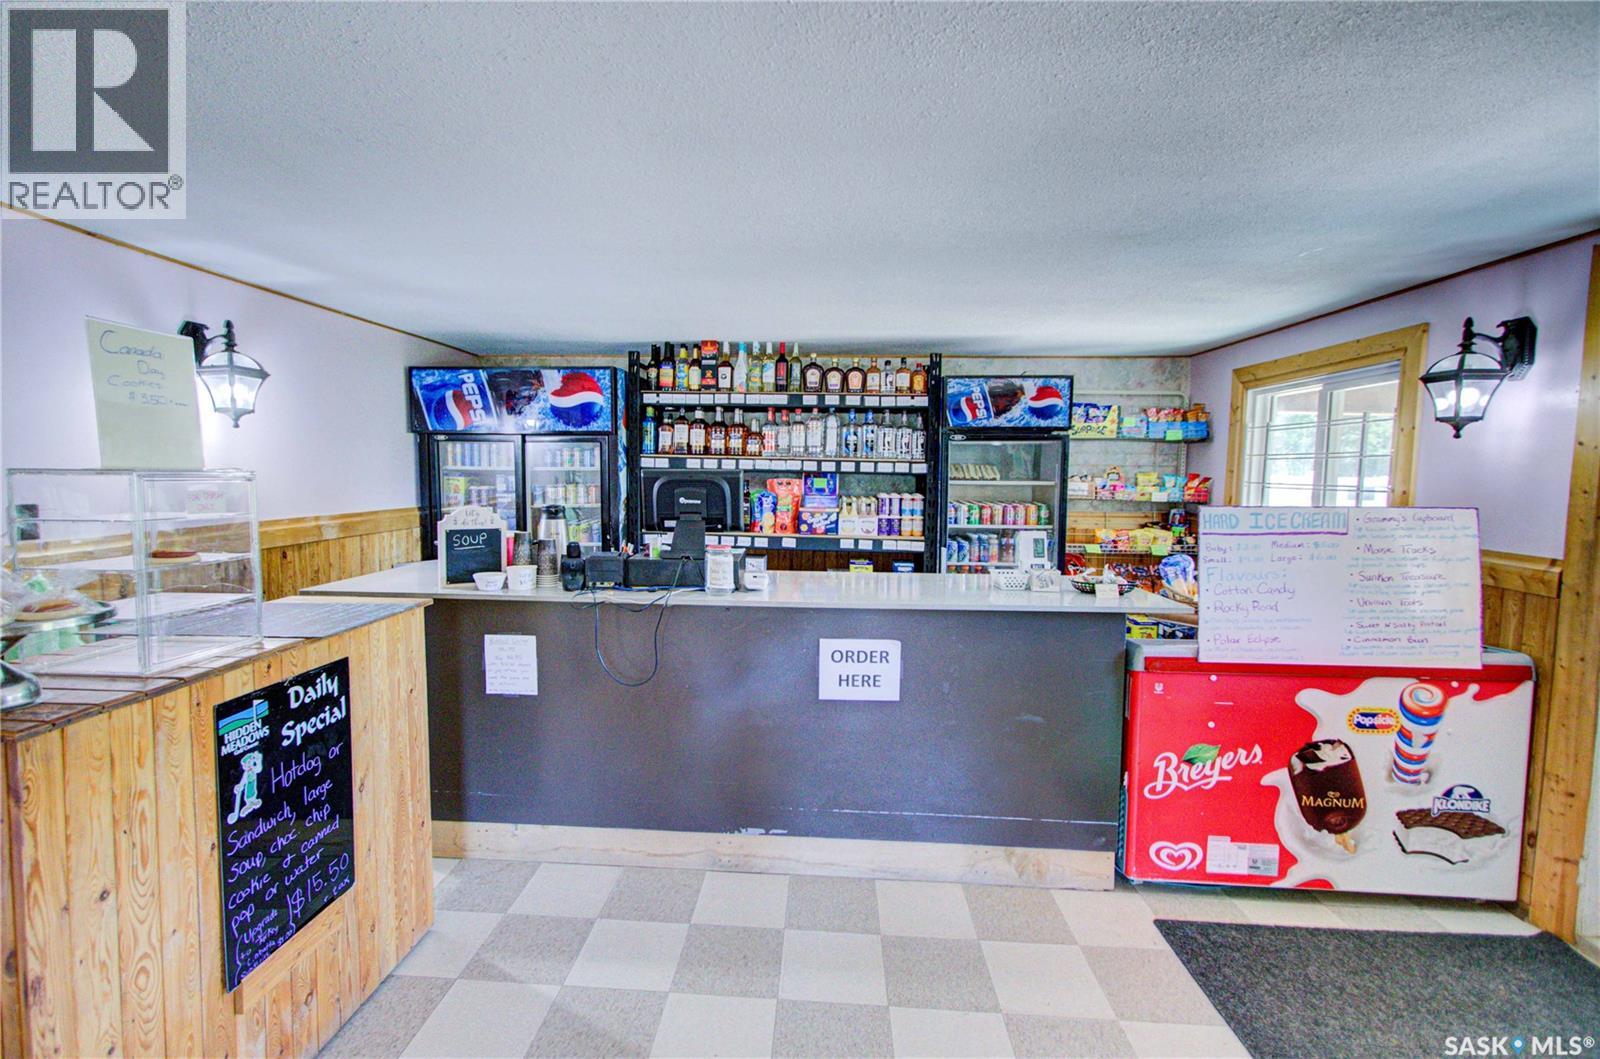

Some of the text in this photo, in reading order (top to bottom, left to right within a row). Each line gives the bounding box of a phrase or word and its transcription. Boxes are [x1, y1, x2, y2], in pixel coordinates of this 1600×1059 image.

[100, 329, 163, 359] Canada
[136, 360, 165, 380] Day
[1202, 513, 1240, 530] HARD
[452, 532, 488, 547] SOUP
[1401, 544, 1437, 556] Tracks
[1400, 572, 1448, 582] Treasure
[1213, 582, 1297, 600] Cotton Candy
[1214, 600, 1280, 618] Rocky Road
[1214, 633, 1241, 646] Polar
[1353, 635, 1402, 644] Cinnamon
[831, 649, 889, 664] ORDER
[287, 672, 339, 709] Daily
[838, 674, 882, 688] HERE
[281, 696, 347, 747] Special
[221, 725, 270, 757] MEADOWS
[224, 719, 262, 744] HIDDEN
[271, 742, 344, 794] Hotdog or
[1143, 744, 1263, 800] Breyers
[303, 779, 333, 806] large
[1301, 795, 1364, 809] MAGNUM
[305, 804, 331, 827] chip
[1432, 798, 1491, 816] KLONDIKE
[228, 872, 271, 910] cookie
[301, 815, 340, 853] canned
[231, 848, 325, 939] pop or water
